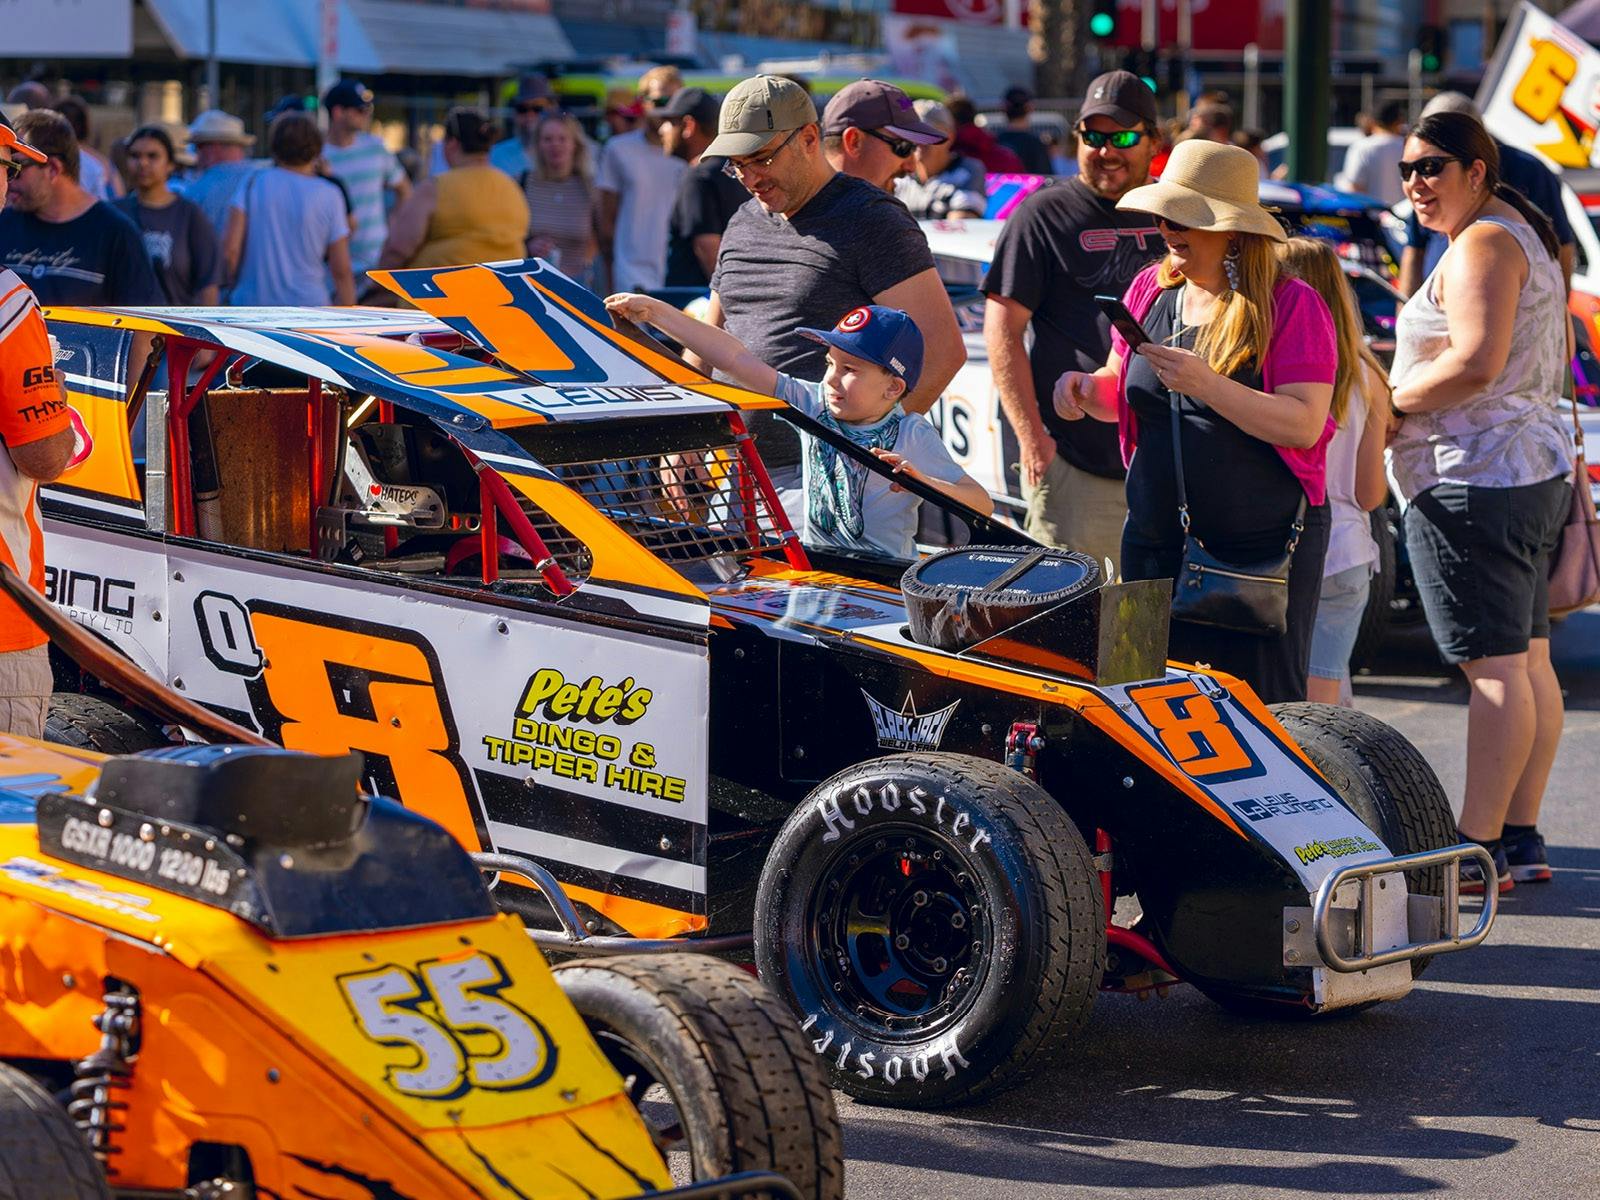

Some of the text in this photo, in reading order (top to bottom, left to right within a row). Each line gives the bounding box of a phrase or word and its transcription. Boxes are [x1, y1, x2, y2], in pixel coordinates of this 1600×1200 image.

[23, 365, 58, 388] GS
[520, 386, 684, 408] LEWIS
[103, 616, 133, 635] LTD
[513, 668, 654, 726] Pete's
[482, 736, 686, 803] TIPPER HIRE
[512, 717, 658, 769] DINGO &
[815, 780, 992, 853] Hoosier
[61, 817, 113, 859] GSXR
[109, 832, 156, 872] 1000
[158, 847, 204, 886] 1200
[1294, 840, 1330, 866] Pete's
[335, 949, 560, 1101] 55
